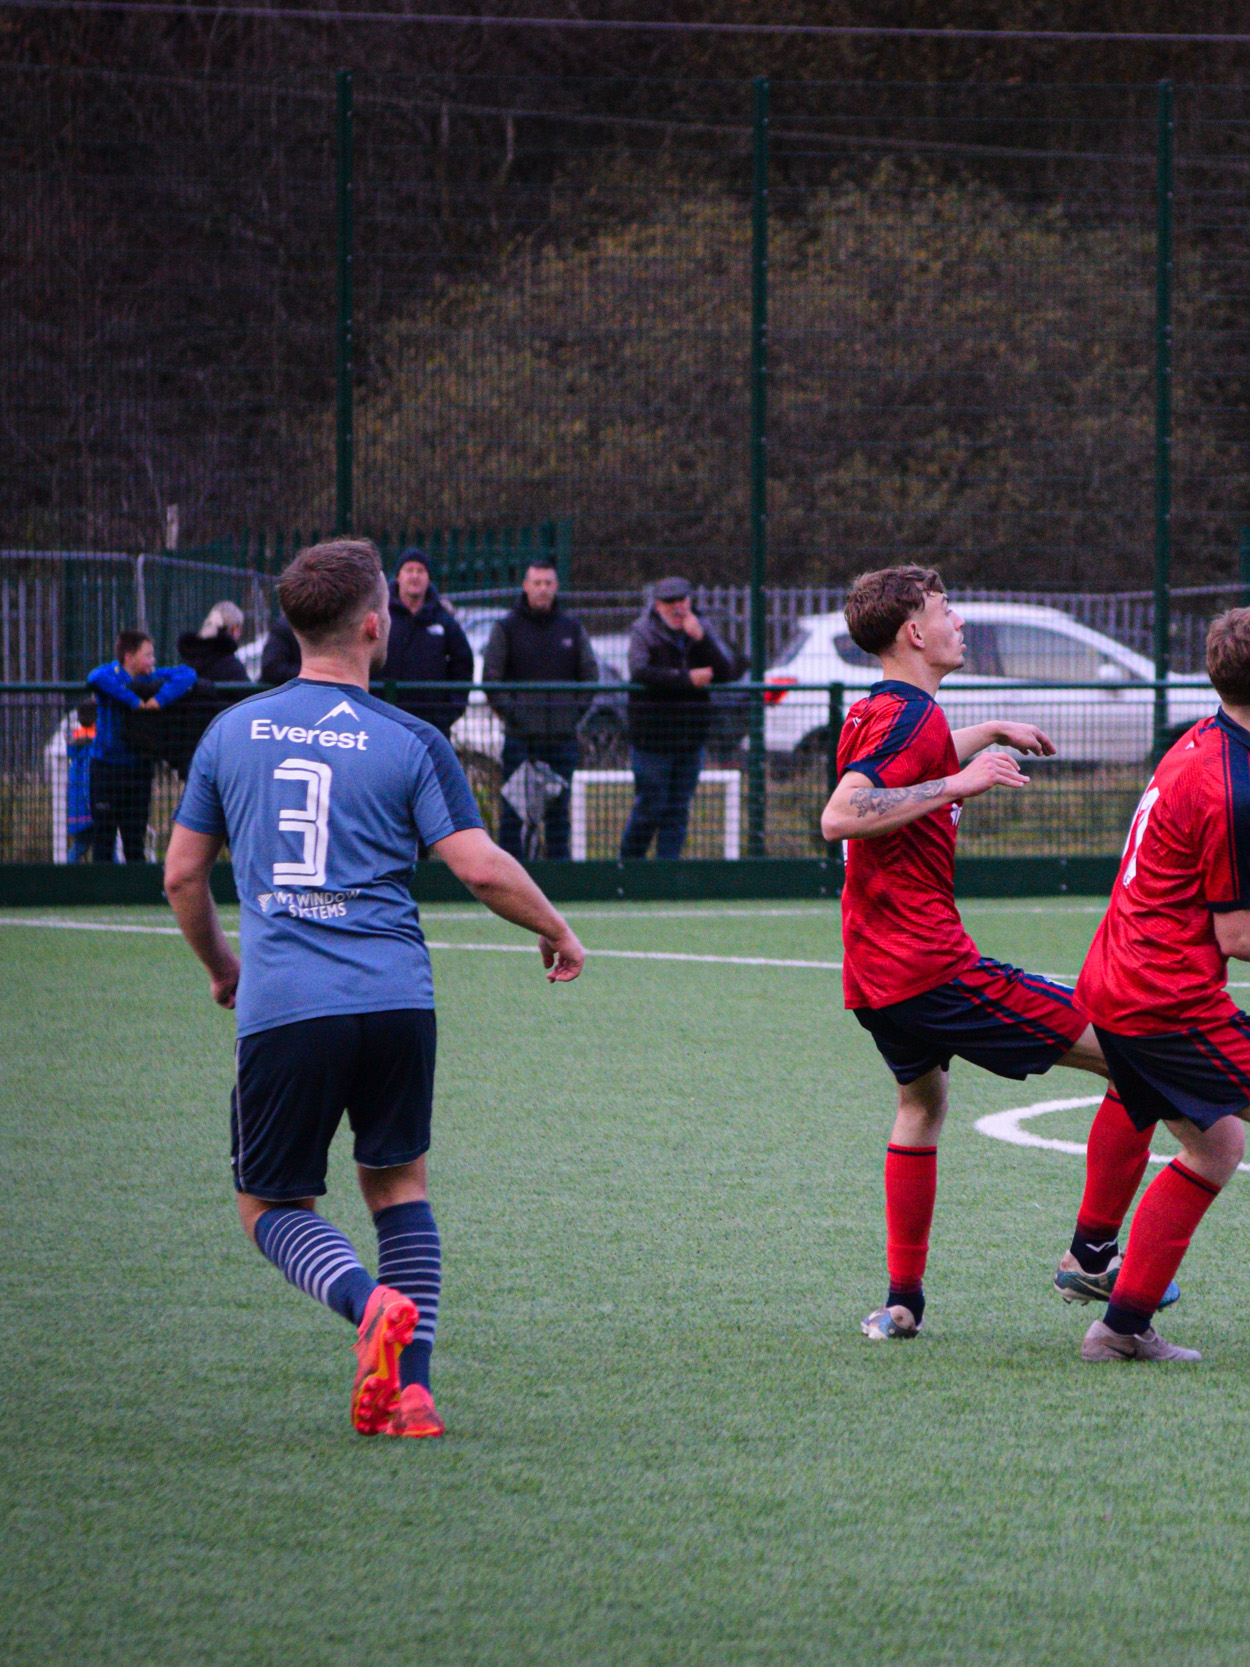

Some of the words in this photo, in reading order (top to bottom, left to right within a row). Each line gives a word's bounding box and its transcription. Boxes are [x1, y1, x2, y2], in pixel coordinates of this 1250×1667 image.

[251, 719, 369, 750] Everest
[273, 758, 332, 886] 3
[296, 888, 361, 907] WINDOW
[288, 902, 348, 920] SYSTEMS
